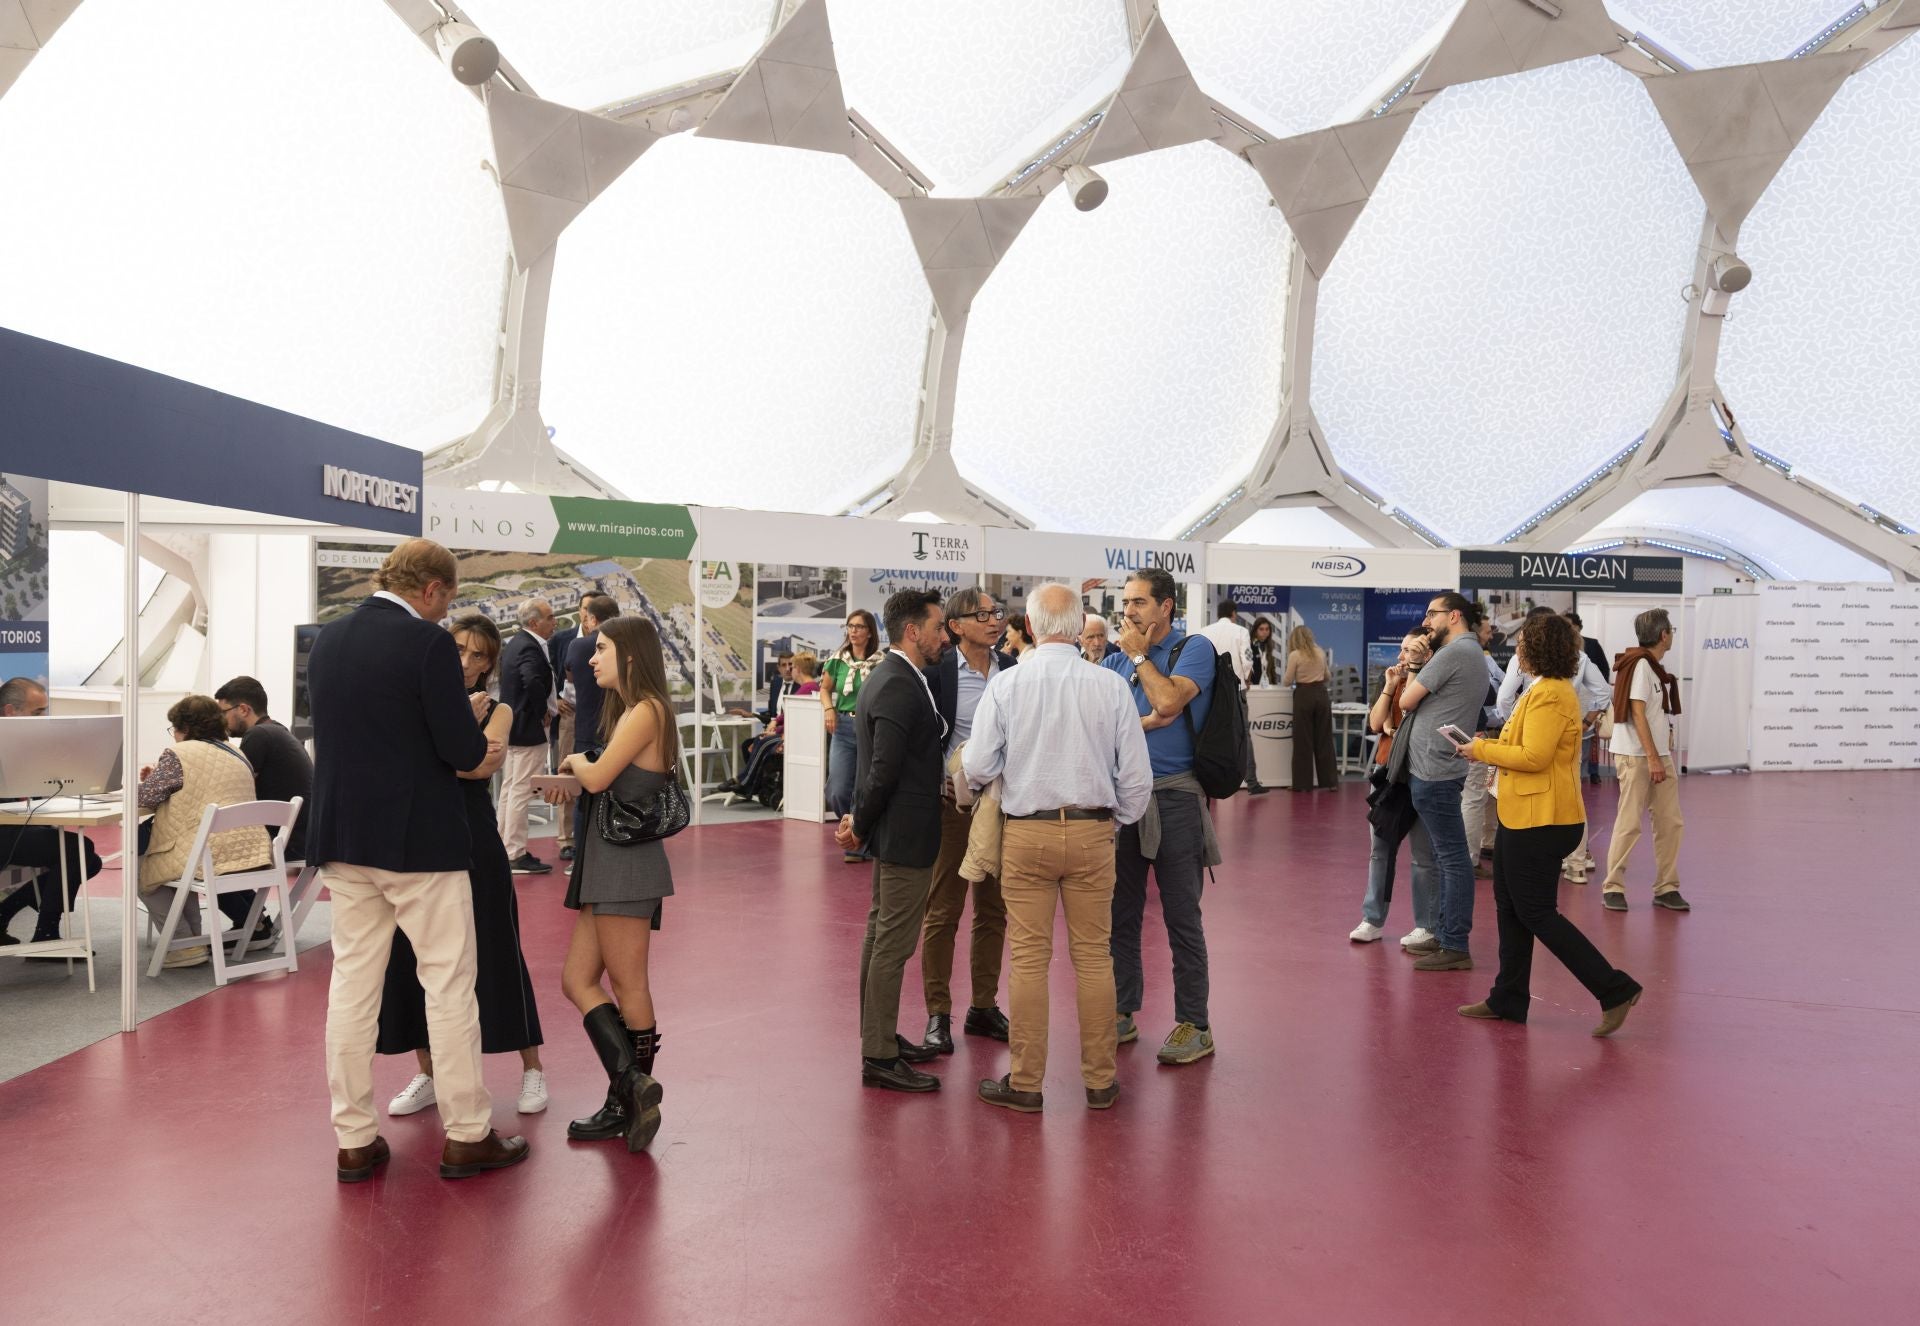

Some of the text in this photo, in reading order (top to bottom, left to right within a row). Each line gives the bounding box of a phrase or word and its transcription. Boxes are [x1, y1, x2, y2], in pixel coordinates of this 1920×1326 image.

[324, 464, 419, 514] NORFOREST
[430, 516, 535, 537] PINOS
[568, 522, 684, 538] www.mirapinos.com
[932, 536, 969, 549] TERRA
[332, 554, 347, 563] DE
[935, 549, 966, 562] SATIS
[1105, 548, 1195, 574] VALLENOVA
[1311, 561, 1352, 570] INBISA
[1521, 555, 1627, 579] PAVALGAN
[1232, 586, 1274, 595] ARCO DE
[1233, 595, 1277, 604] LADRILLO
[1341, 603, 1347, 612] 3
[1355, 603, 1361, 612] 4
[0, 630, 41, 644] TORIOS
[1248, 720, 1293, 730] INBISA
